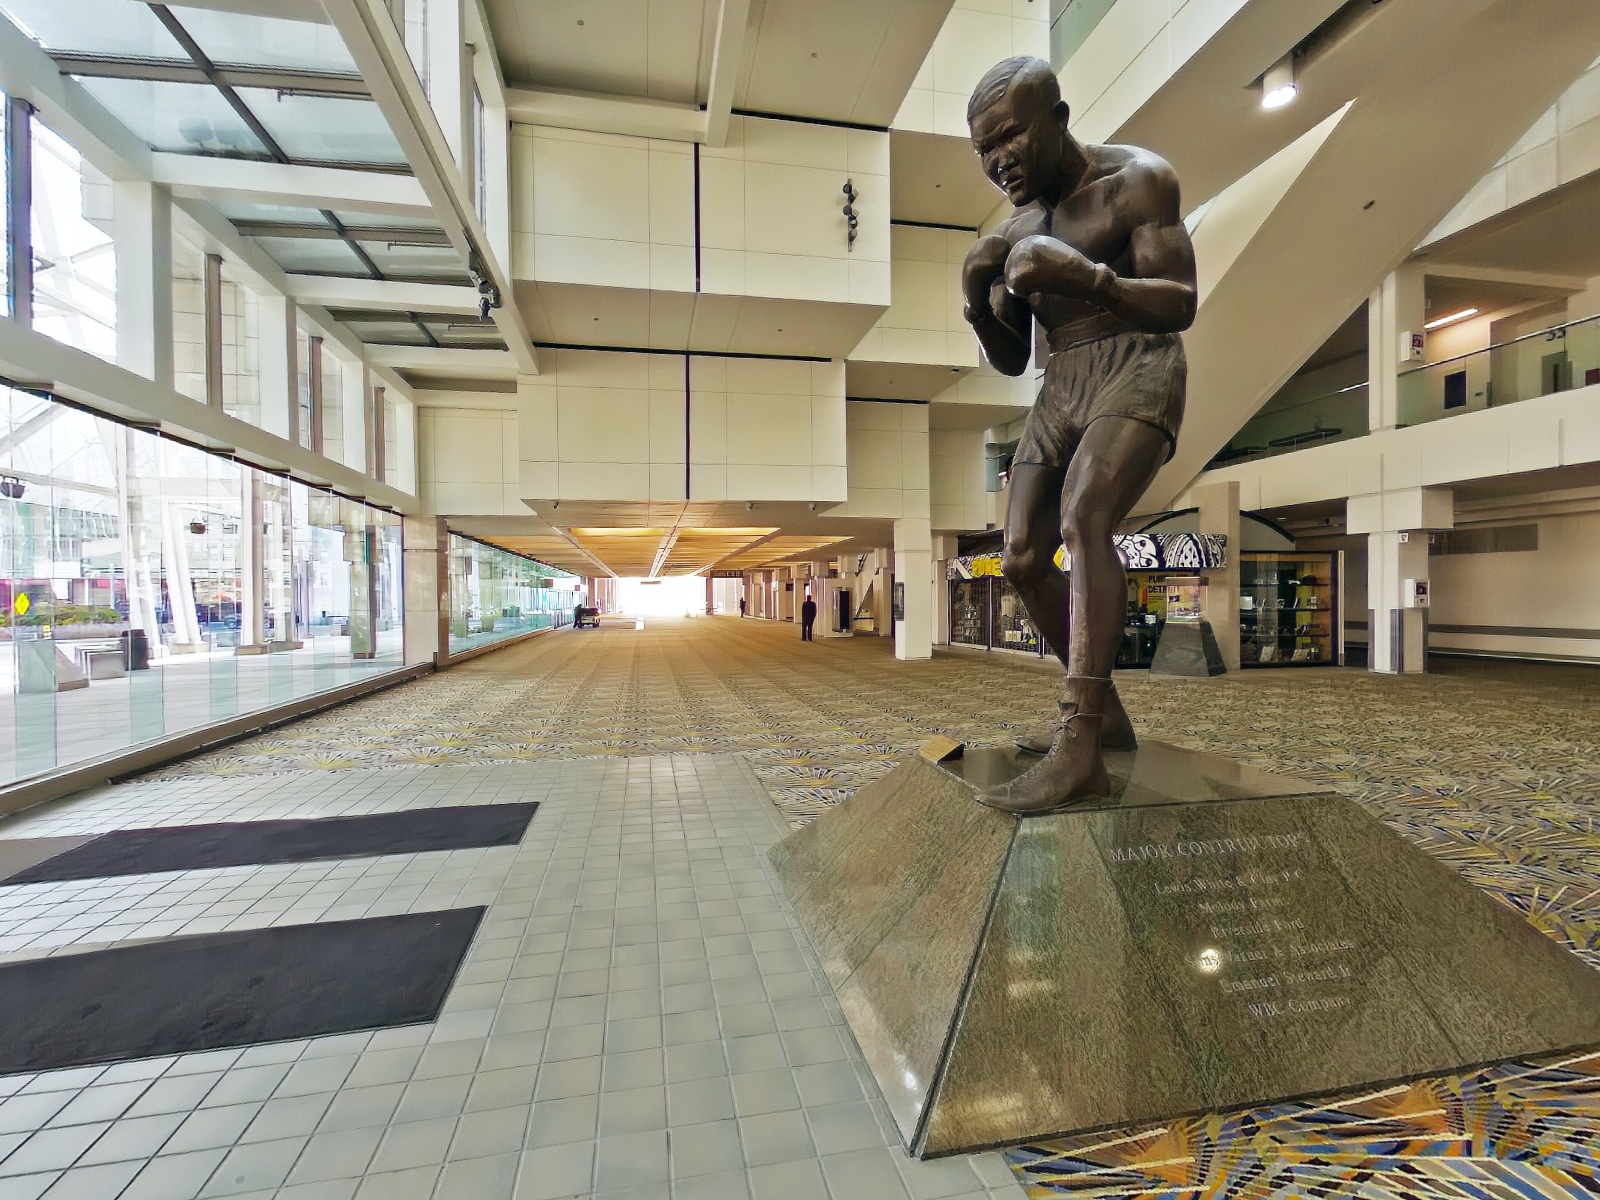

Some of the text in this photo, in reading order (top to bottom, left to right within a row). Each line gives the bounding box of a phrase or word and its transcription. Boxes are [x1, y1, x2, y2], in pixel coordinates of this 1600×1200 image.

[1109, 844, 1174, 862] MAJOR
[1219, 973, 1280, 993] Emanuel
[1288, 997, 1351, 1013] Company
